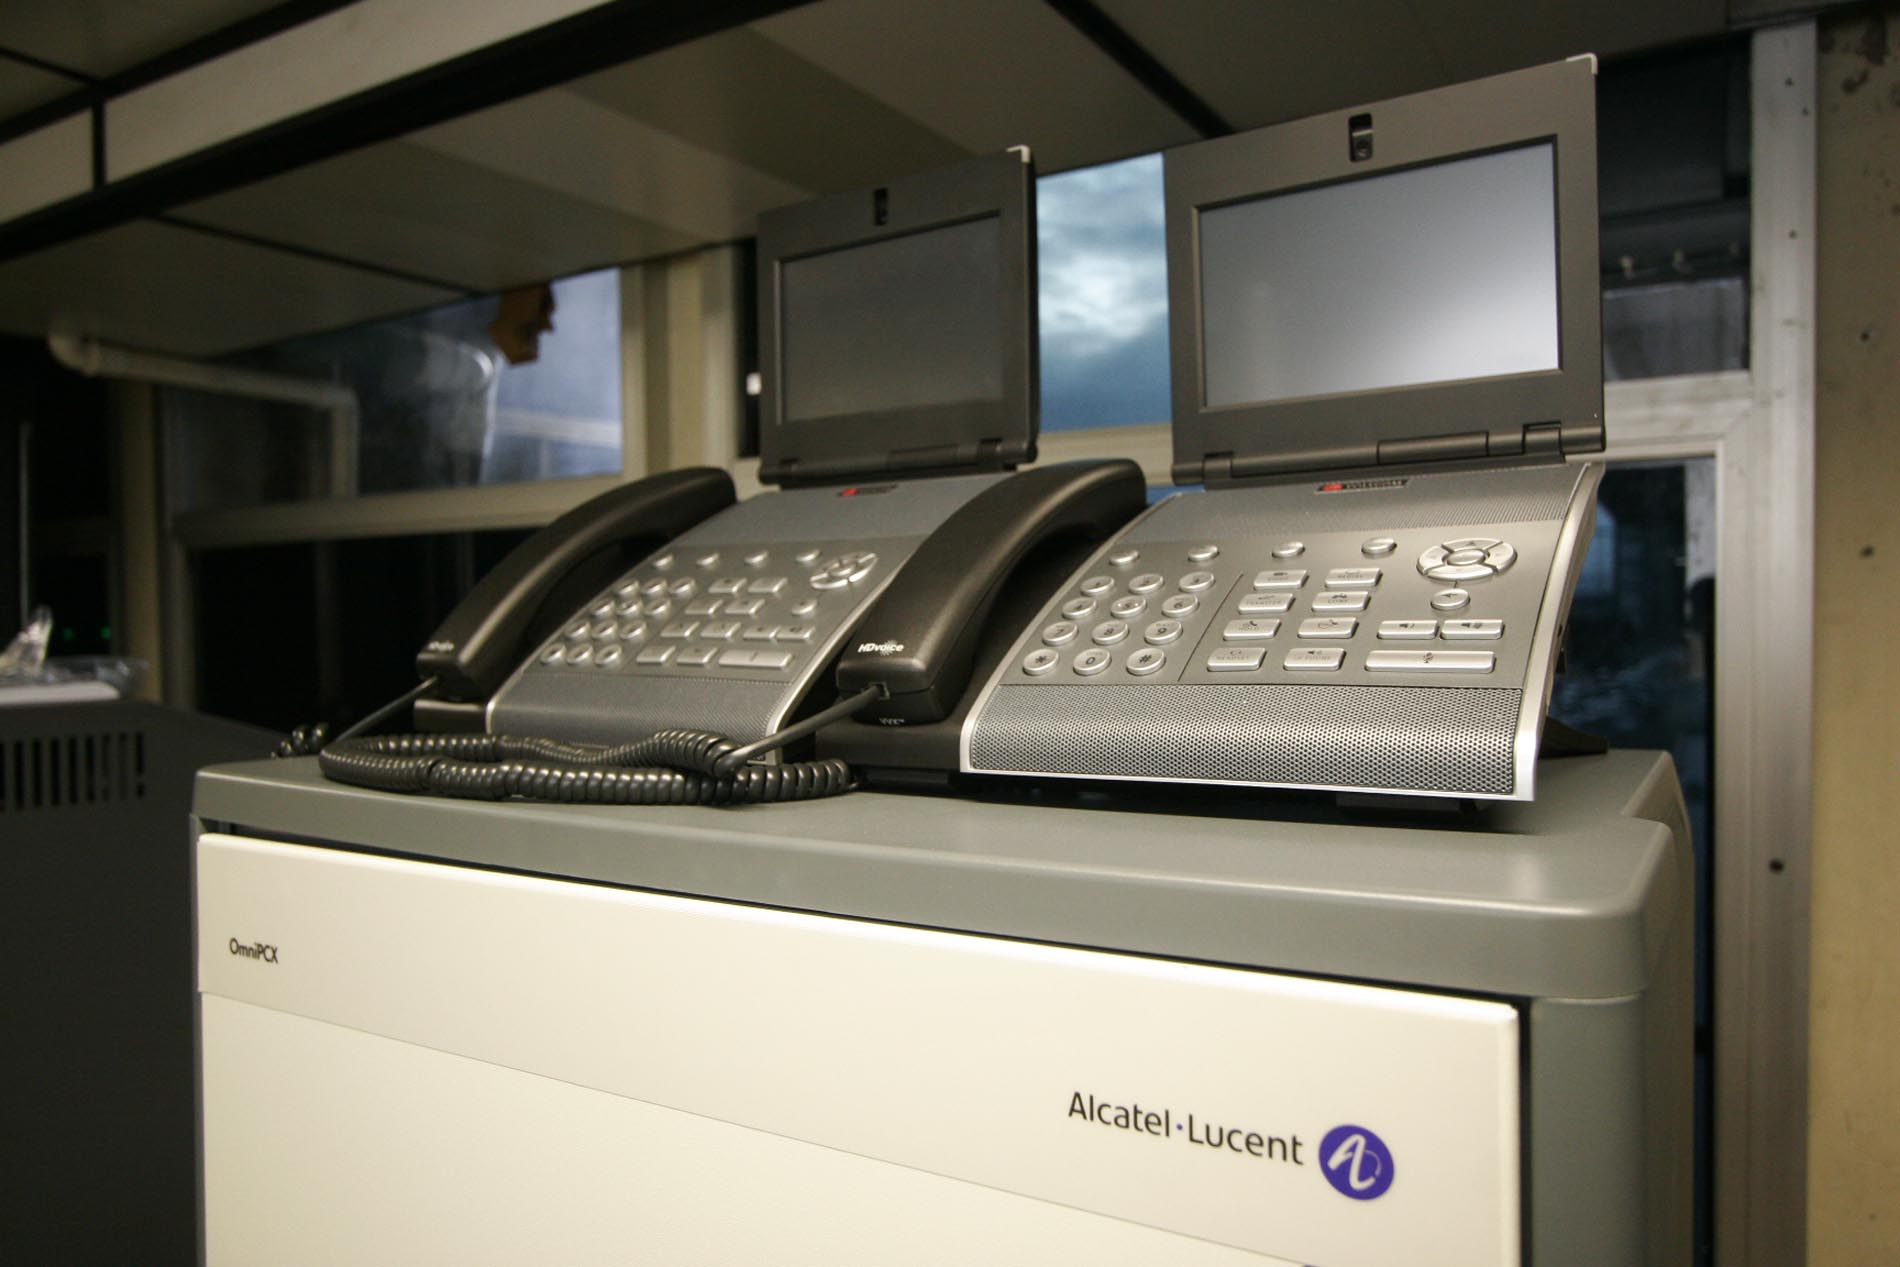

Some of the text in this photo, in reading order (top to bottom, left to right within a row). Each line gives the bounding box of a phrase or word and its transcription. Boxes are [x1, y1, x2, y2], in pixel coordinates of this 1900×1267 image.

[857, 642, 905, 654] HDvoice
[1085, 655, 1097, 665] 0
[229, 937, 279, 965] OmniPCX
